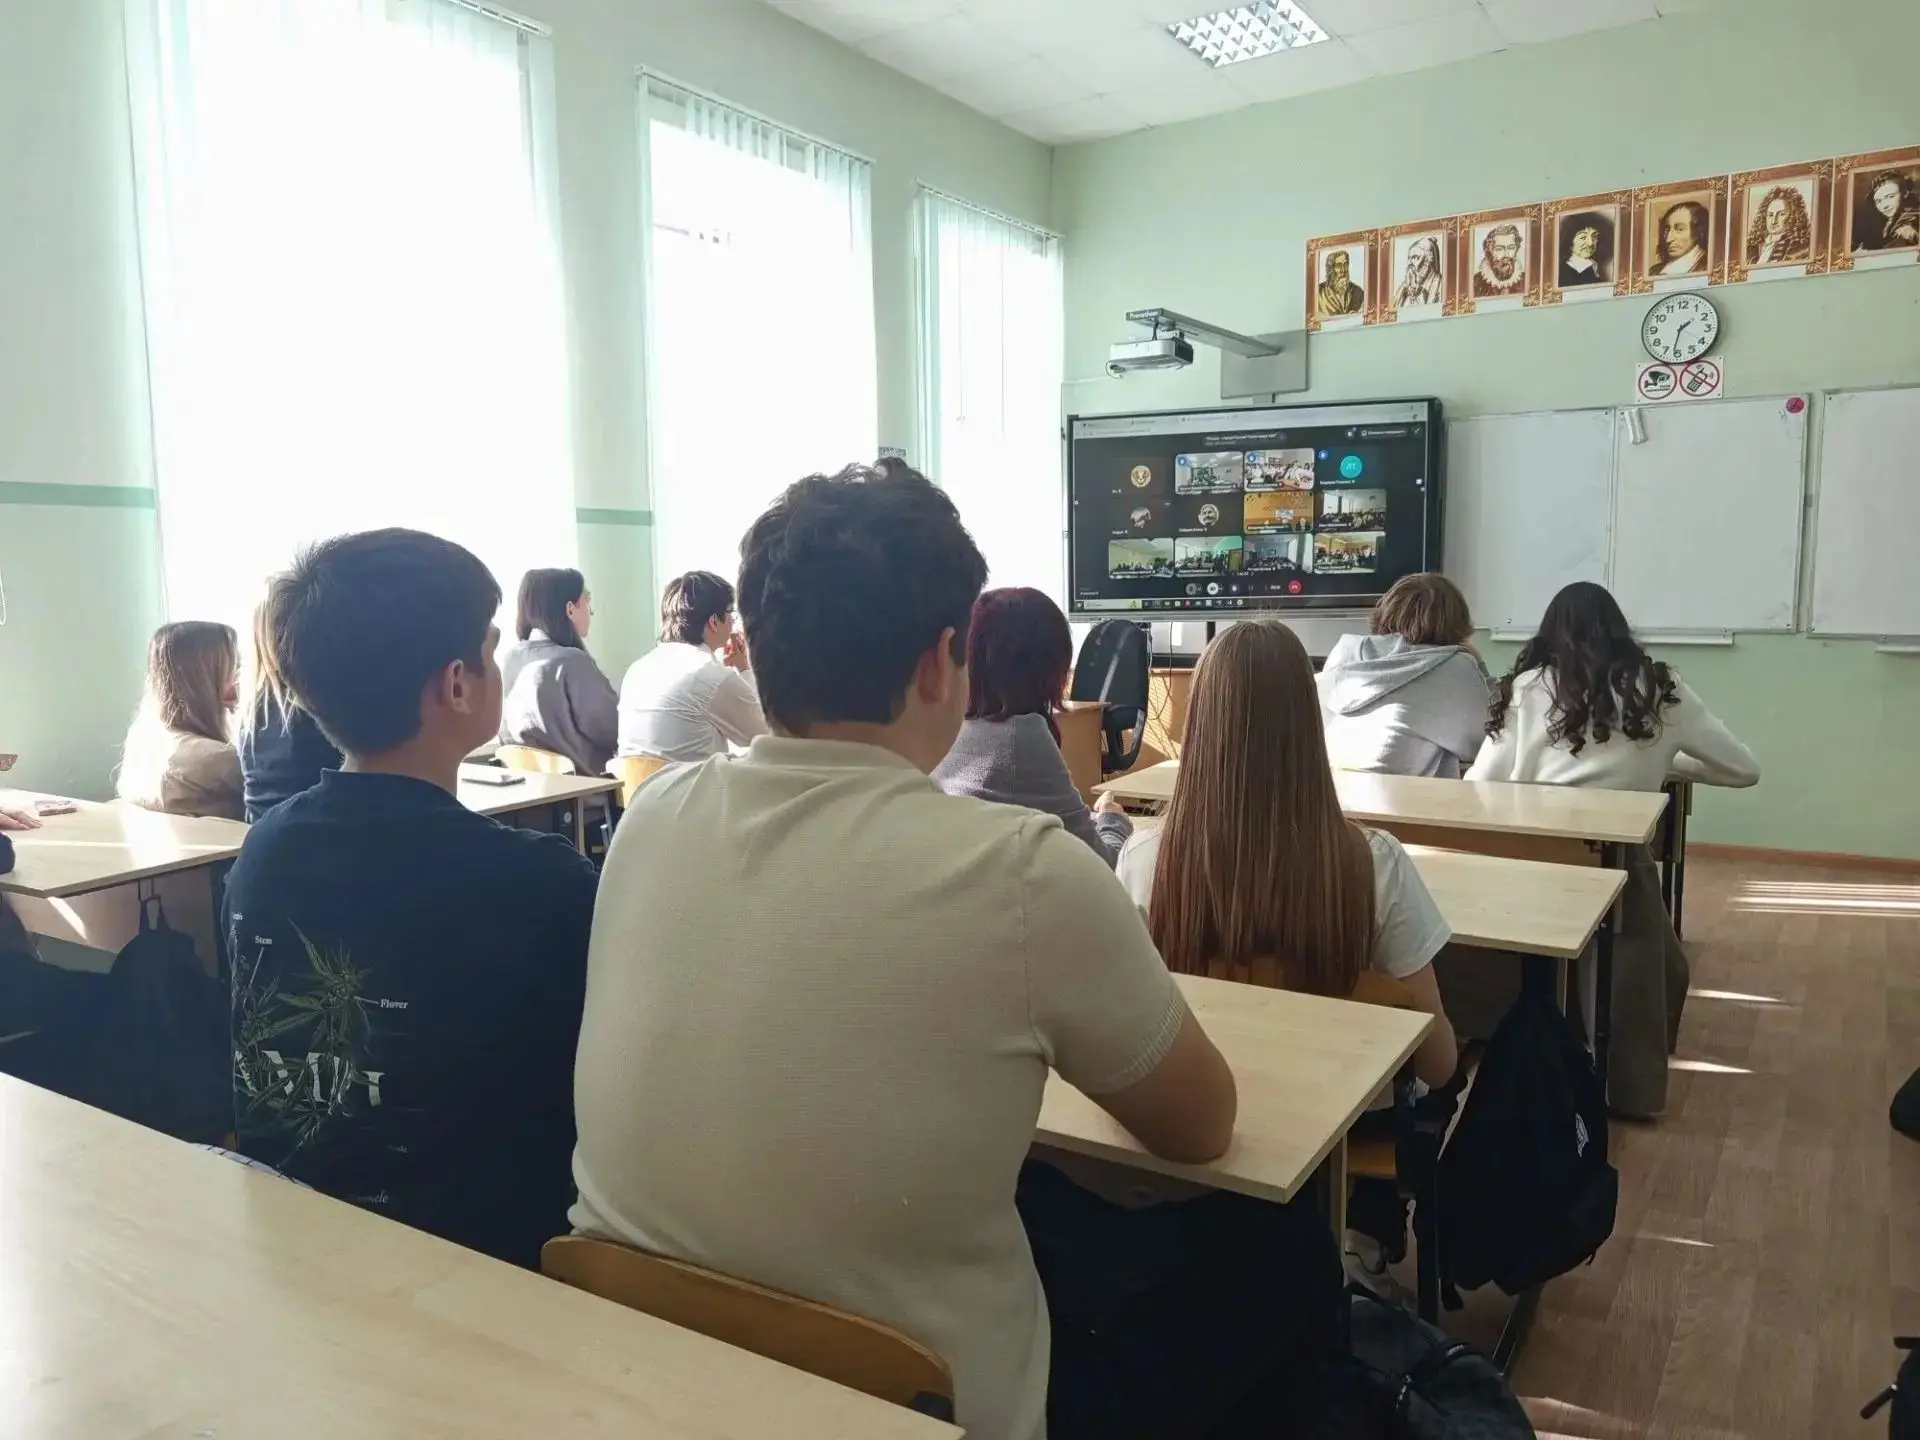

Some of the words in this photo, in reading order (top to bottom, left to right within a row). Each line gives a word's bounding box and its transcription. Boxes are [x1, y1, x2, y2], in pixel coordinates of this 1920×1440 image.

[1666, 305, 1674, 313] 11
[1678, 300, 1689, 310] 12
[1694, 304, 1699, 312] 1
[1655, 314, 1667, 323] 10
[1701, 313, 1709, 321] 2
[1650, 326, 1658, 335] 9
[1704, 324, 1712, 333] 3
[1653, 338, 1661, 347] 8
[1698, 337, 1706, 345] 4
[1662, 346, 1670, 355] 7
[1673, 349, 1682, 358] 6
[1688, 345, 1696, 354] 5
